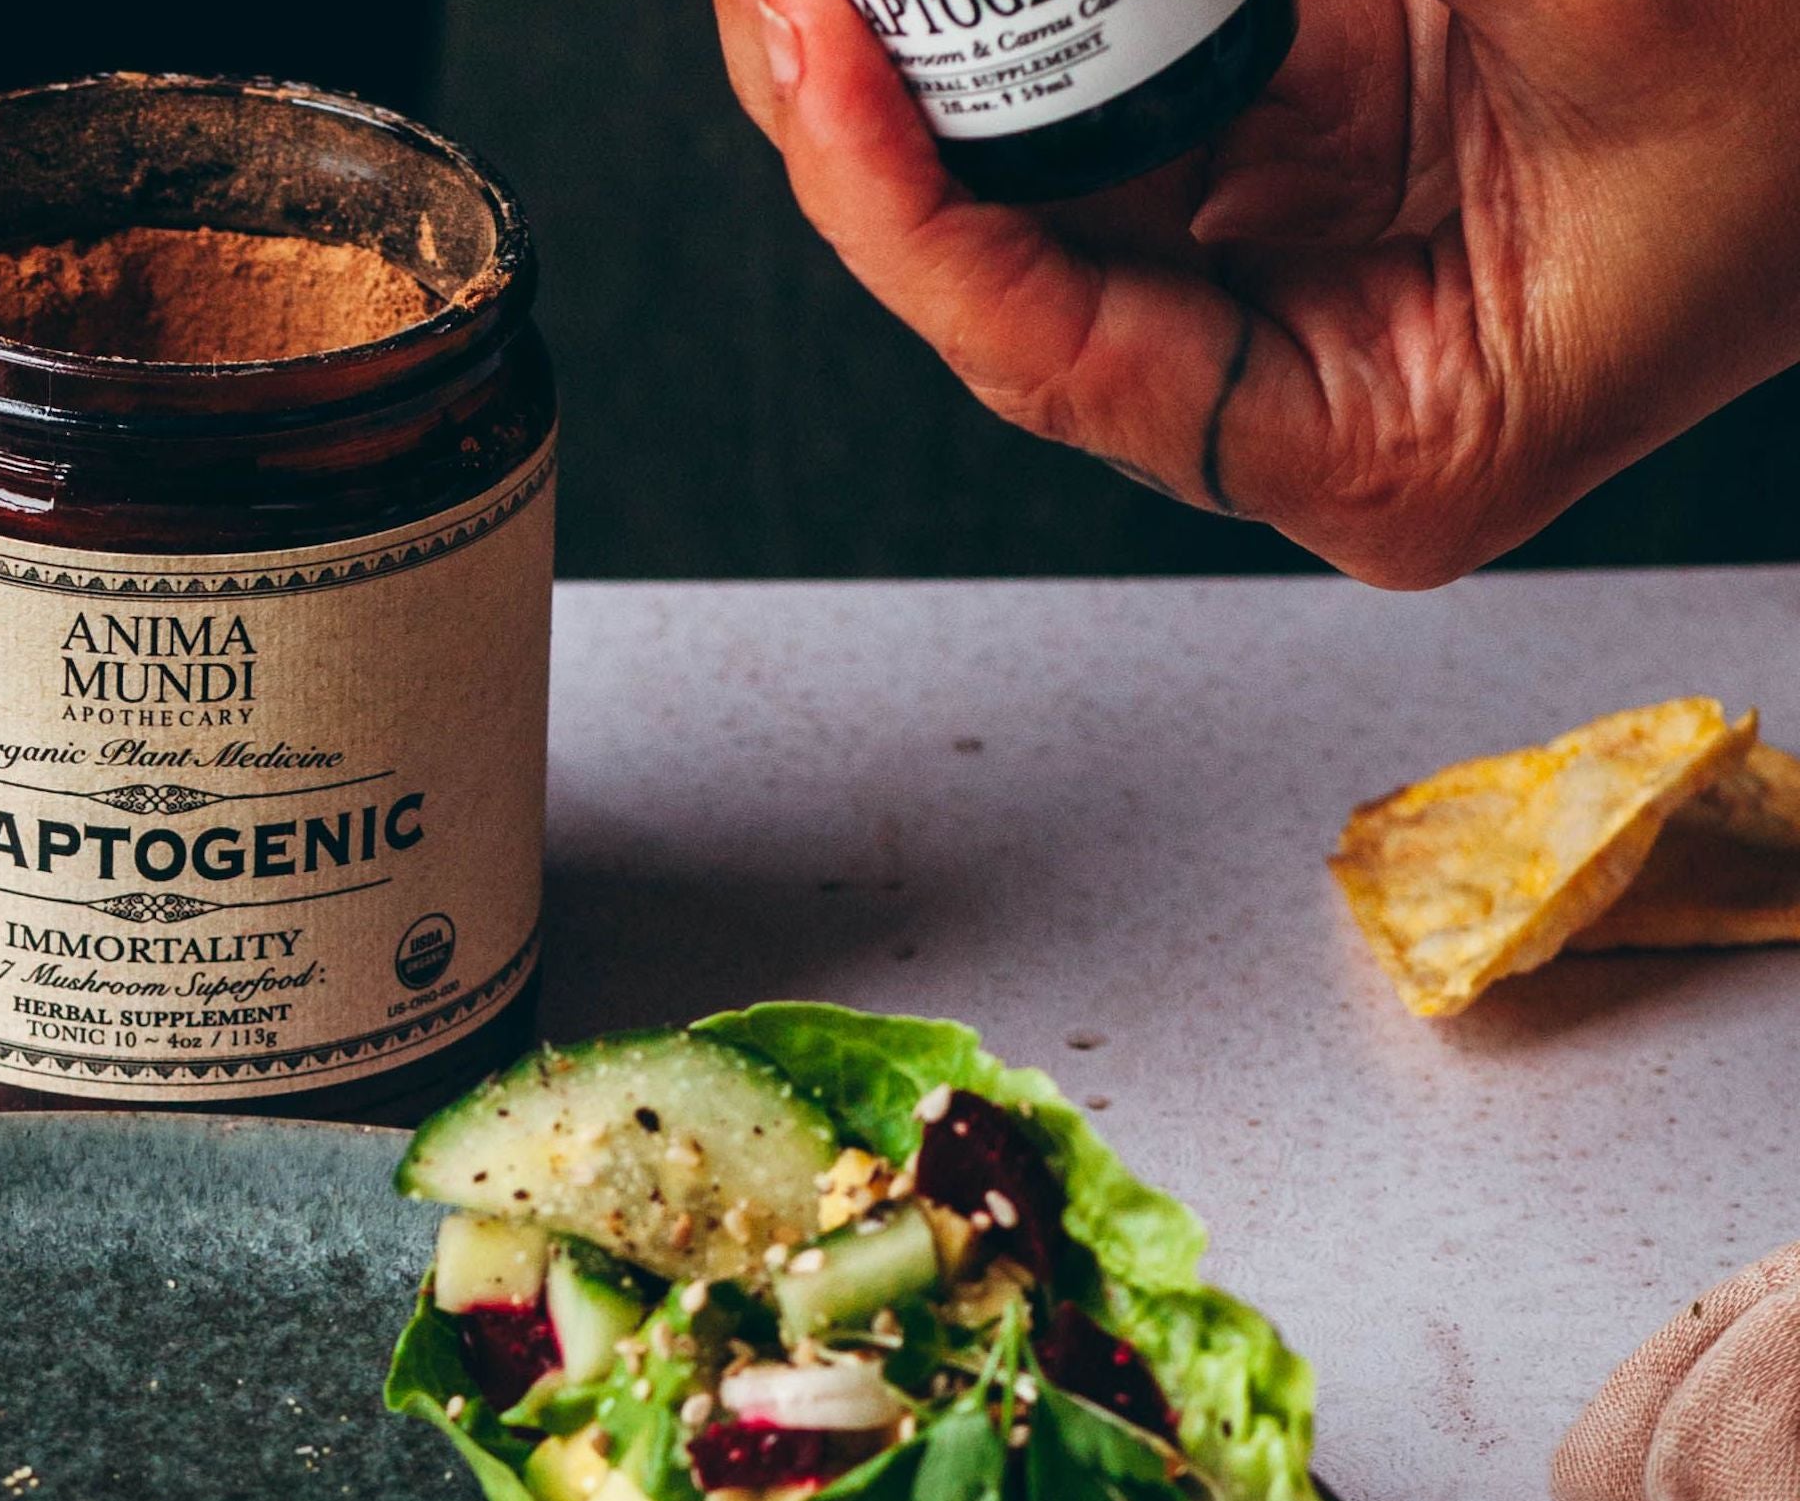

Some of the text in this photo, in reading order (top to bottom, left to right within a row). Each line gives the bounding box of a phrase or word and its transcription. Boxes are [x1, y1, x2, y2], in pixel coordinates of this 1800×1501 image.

[972, 32, 1104, 88] SUPPLEMENT
[61, 611, 258, 657] ANIMA
[61, 657, 257, 704] MUNDI
[61, 705, 254, 727] APOTHECARY
[94, 739, 193, 767] Plant
[192, 741, 344, 769] Medicine
[4, 920, 303, 964] IMMORTALITY
[21, 961, 171, 997] Mushroom
[12, 995, 292, 1029] HERBAL SUPPLEMENT
[26, 1018, 105, 1046] TONIC
[115, 1031, 137, 1049] 10
[166, 1031, 203, 1049] 4oz
[210, 1031, 222, 1049] /
[231, 1029, 278, 1048] 113g
